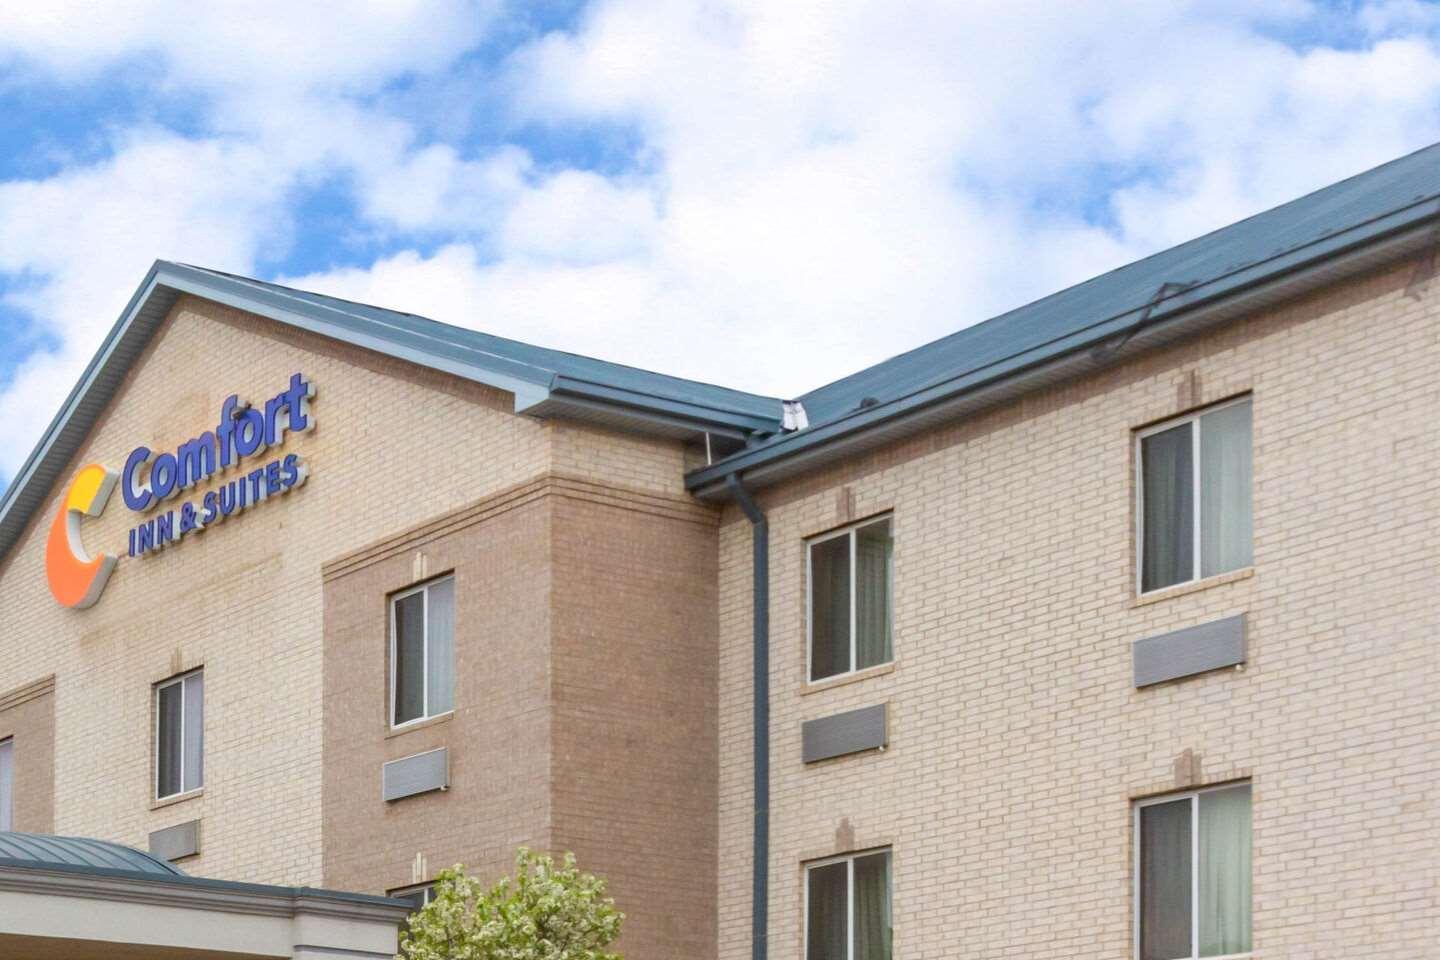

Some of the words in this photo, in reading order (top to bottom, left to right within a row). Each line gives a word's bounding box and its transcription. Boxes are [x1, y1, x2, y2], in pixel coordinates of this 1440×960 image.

[122, 372, 312, 512] Comfort
[128, 510, 174, 557] INN
[180, 501, 198, 534] &
[202, 454, 299, 525] SUITES
